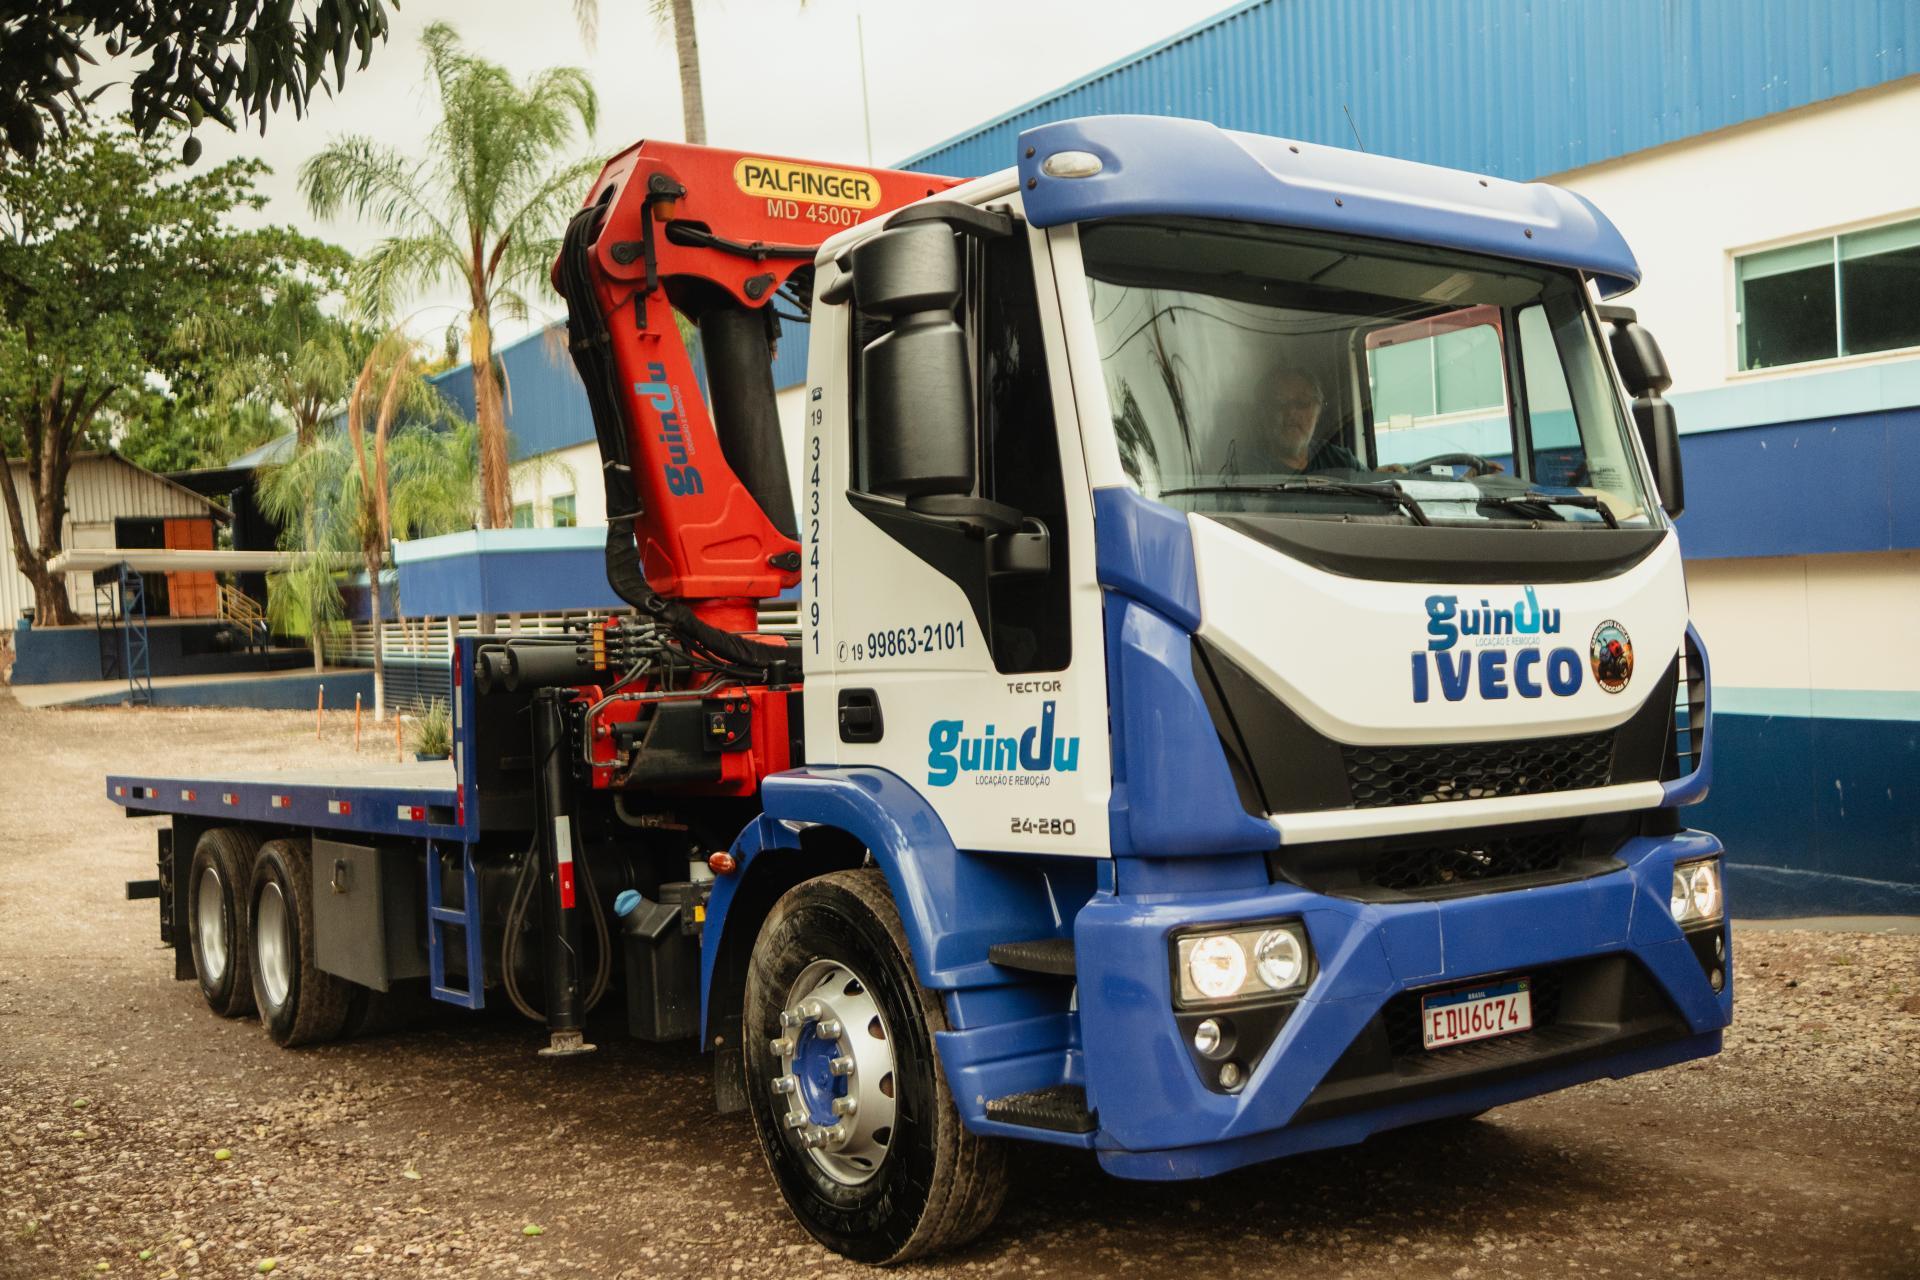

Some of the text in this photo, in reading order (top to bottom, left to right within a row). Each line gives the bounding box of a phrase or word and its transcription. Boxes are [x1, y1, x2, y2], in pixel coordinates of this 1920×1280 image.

[744, 164, 872, 202] PALFINGER
[767, 198, 862, 227] MD 45007
[634, 362, 704, 496] guindu
[811, 408, 823, 427] 19
[1425, 584, 1561, 652] guindu
[851, 620, 965, 661] 19 99863-2101
[1007, 680, 1062, 694] TECTOR
[1411, 647, 1584, 704] IVECO
[927, 700, 1080, 788] guindu
[1008, 776, 1014, 786] E
[1011, 817, 1076, 836] 24-280
[1433, 998, 1519, 1041] EDU6C74
